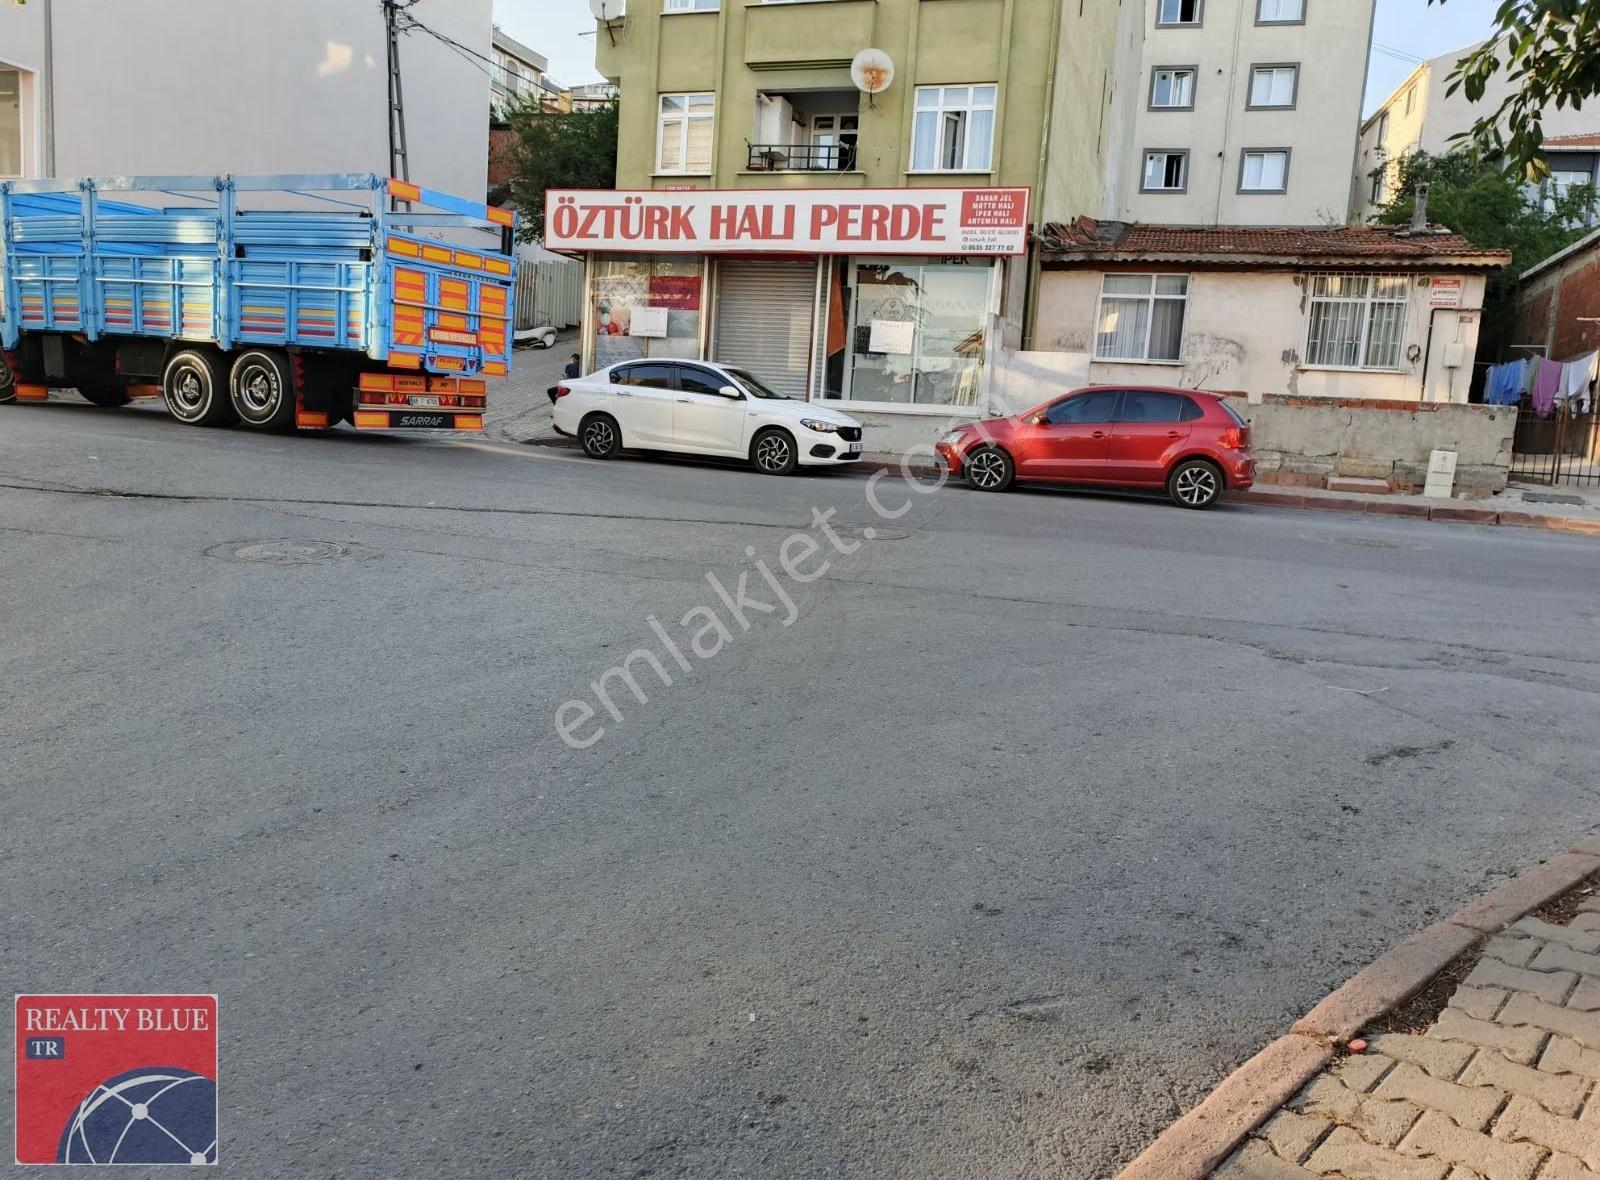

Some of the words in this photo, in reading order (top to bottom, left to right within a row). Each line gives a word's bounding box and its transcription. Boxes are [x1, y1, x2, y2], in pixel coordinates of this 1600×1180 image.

[999, 194, 1013, 202] JEL
[997, 202, 1015, 210] HALI
[975, 209, 992, 217] İPEK
[552, 196, 697, 240] ÖZTÜRK
[709, 204, 796, 241] HALI
[809, 204, 947, 241] PERDE
[999, 217, 1016, 225] HALI
[400, 416, 444, 426] SARRAF
